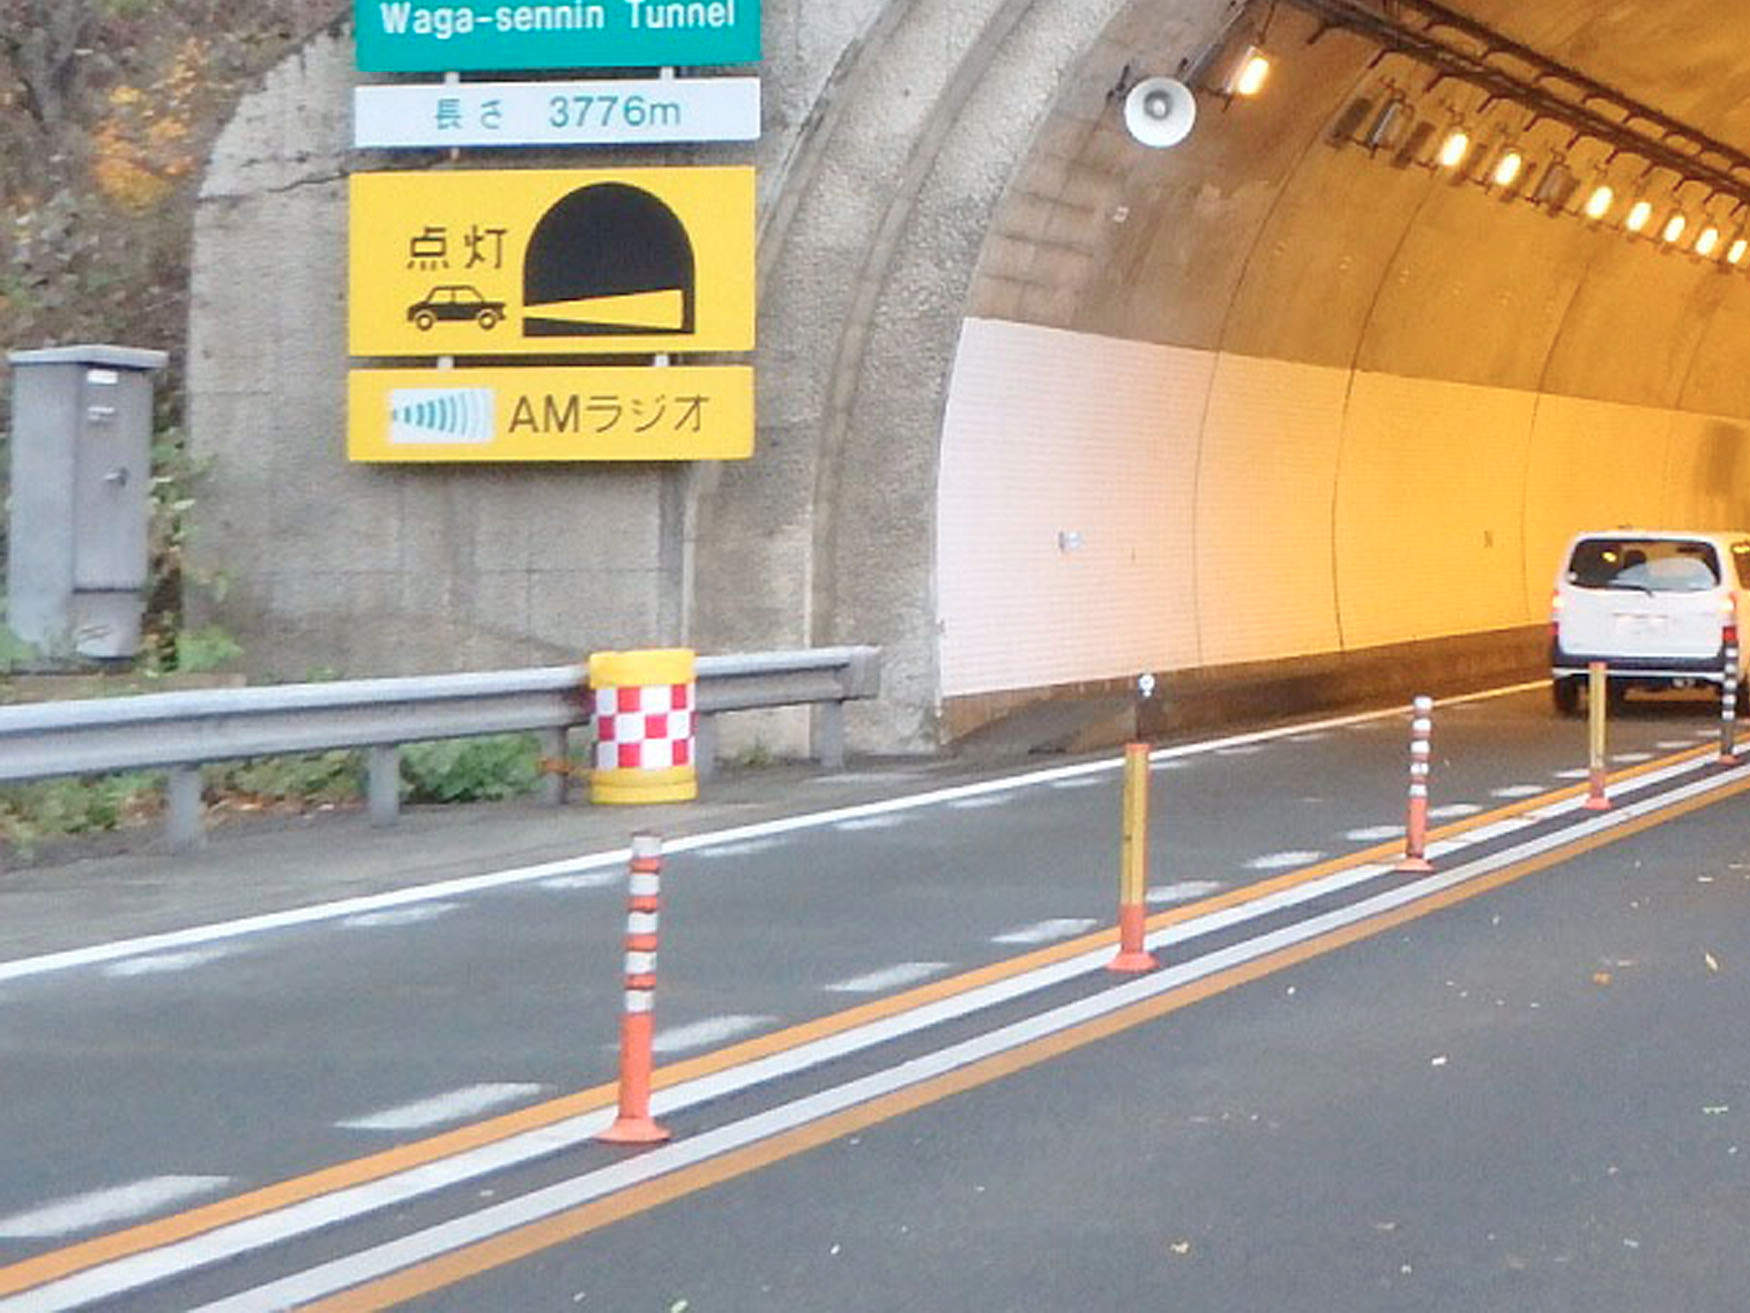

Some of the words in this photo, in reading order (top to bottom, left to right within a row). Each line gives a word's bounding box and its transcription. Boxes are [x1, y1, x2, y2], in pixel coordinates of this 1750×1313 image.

[435, 98, 503, 131] 長さ
[549, 95, 682, 128] 3776m
[406, 225, 508, 271] 点灯
[508, 394, 711, 434] AMラジオ
